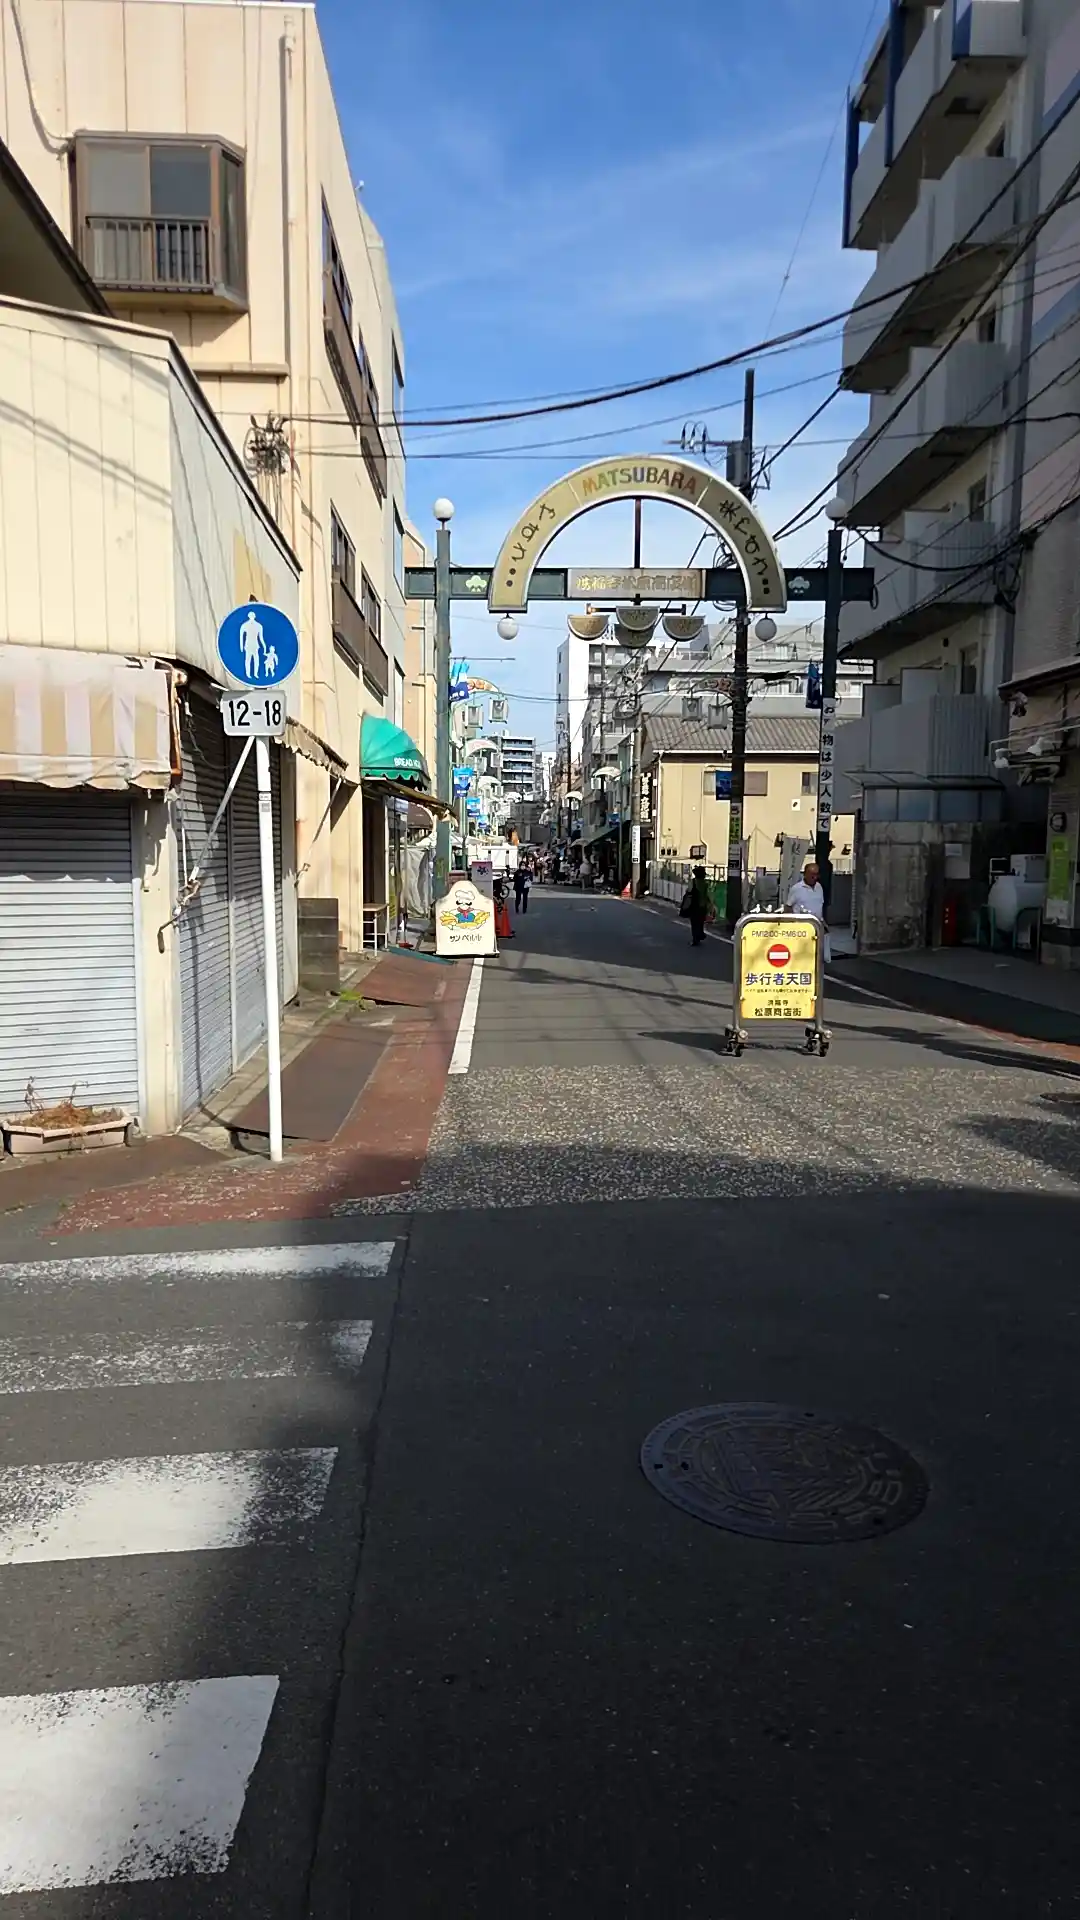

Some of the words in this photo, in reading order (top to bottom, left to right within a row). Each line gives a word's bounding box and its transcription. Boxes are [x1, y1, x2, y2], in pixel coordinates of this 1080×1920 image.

[583, 467, 697, 496] MATSUBARA
[229, 701, 281, 727] 12-18
[394, 757, 413, 767] BREAD
[745, 972, 811, 985] 歩行者天国
[754, 1008, 802, 1016] 松原商店街
